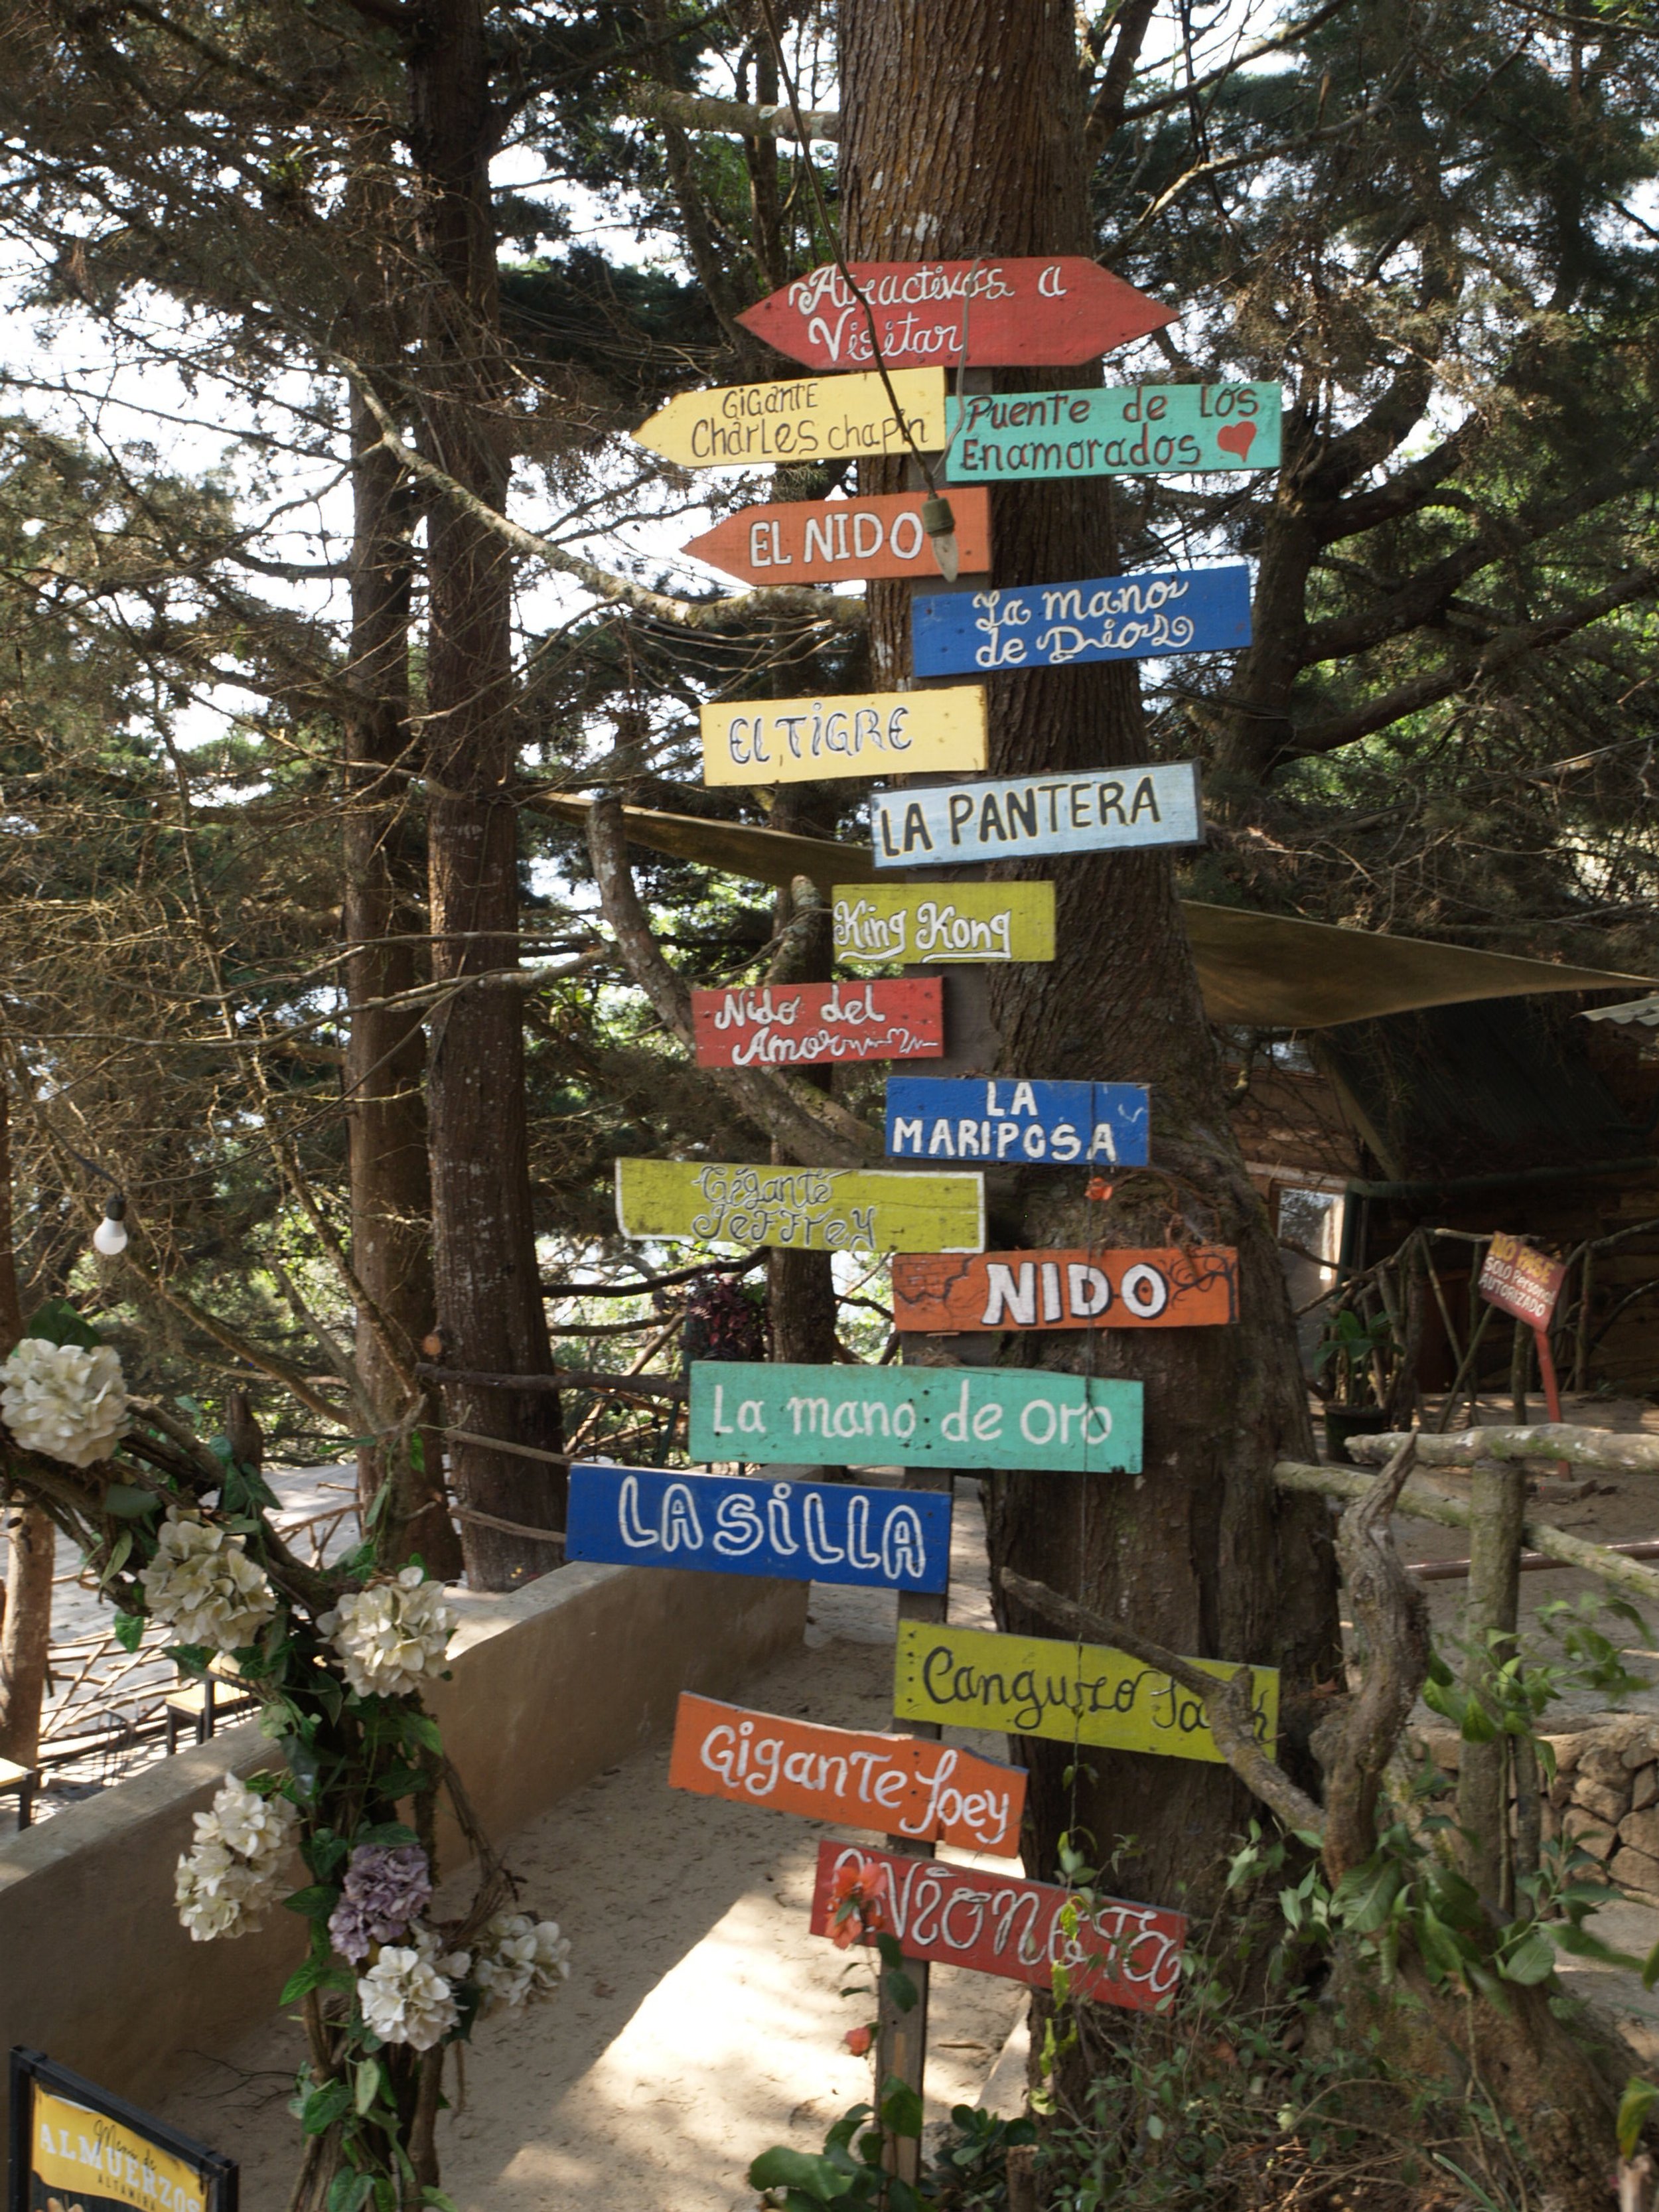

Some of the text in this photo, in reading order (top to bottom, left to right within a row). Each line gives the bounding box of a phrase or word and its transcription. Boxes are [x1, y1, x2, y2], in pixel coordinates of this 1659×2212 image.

[808, 307, 964, 362] Visitar
[1123, 386, 1169, 422] de
[963, 422, 1200, 471] Enamorados
[750, 511, 924, 567] EL NIDO
[972, 580, 1189, 630] La mano
[975, 627, 1028, 667] de
[881, 774, 1161, 857] LA PANTERA
[833, 899, 1012, 963] King Kong
[715, 984, 886, 1029] Nido del
[986, 1081, 1038, 1116] LA
[893, 1116, 1117, 1162] MARIPOSA
[1484, 1256, 1512, 1280] SOLO
[1491, 1234, 1555, 1284] NO PASE
[981, 1262, 1169, 1325] NIDO
[1478, 1273, 1546, 1317] AUTORIZADO
[713, 1384, 766, 1434] La
[788, 1397, 916, 1439] mano
[941, 1379, 1003, 1442] de
[619, 1476, 703, 1552] LA
[899, 1749, 1009, 1845] Joey
